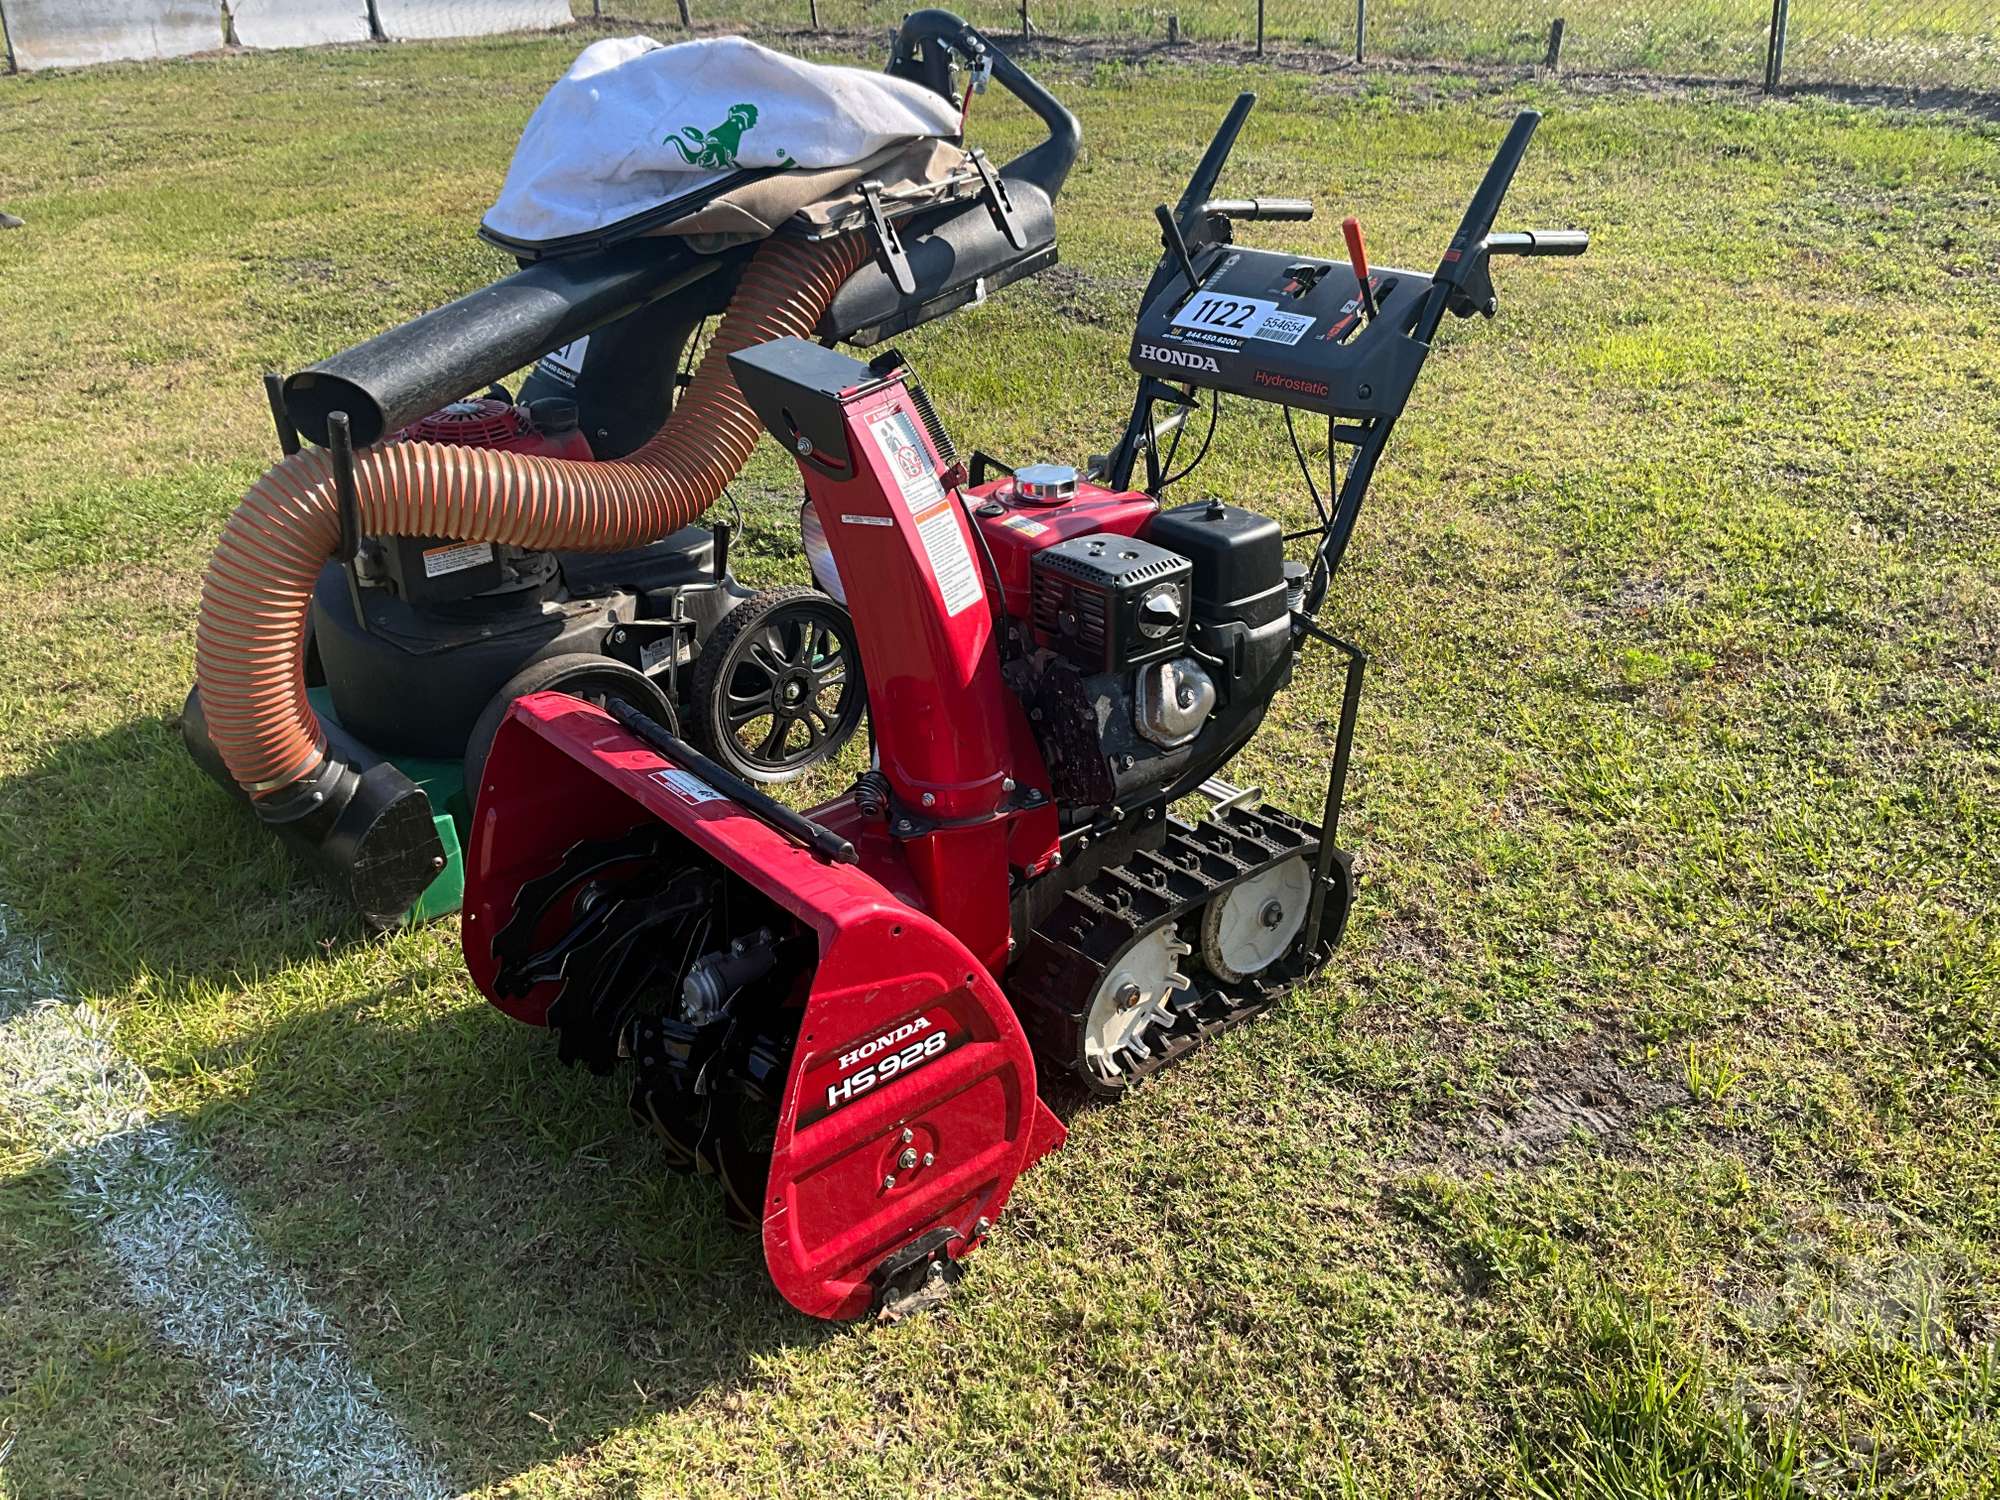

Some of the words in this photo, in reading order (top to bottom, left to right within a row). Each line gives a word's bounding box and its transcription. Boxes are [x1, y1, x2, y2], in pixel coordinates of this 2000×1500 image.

[1192, 299, 1256, 329] 1122
[1262, 317, 1306, 333] 554654
[1139, 343, 1220, 373] HONDA
[1255, 370, 1328, 396] Hydrostatic
[839, 1017, 932, 1070] HONDA
[828, 1031, 948, 1107] HS928
